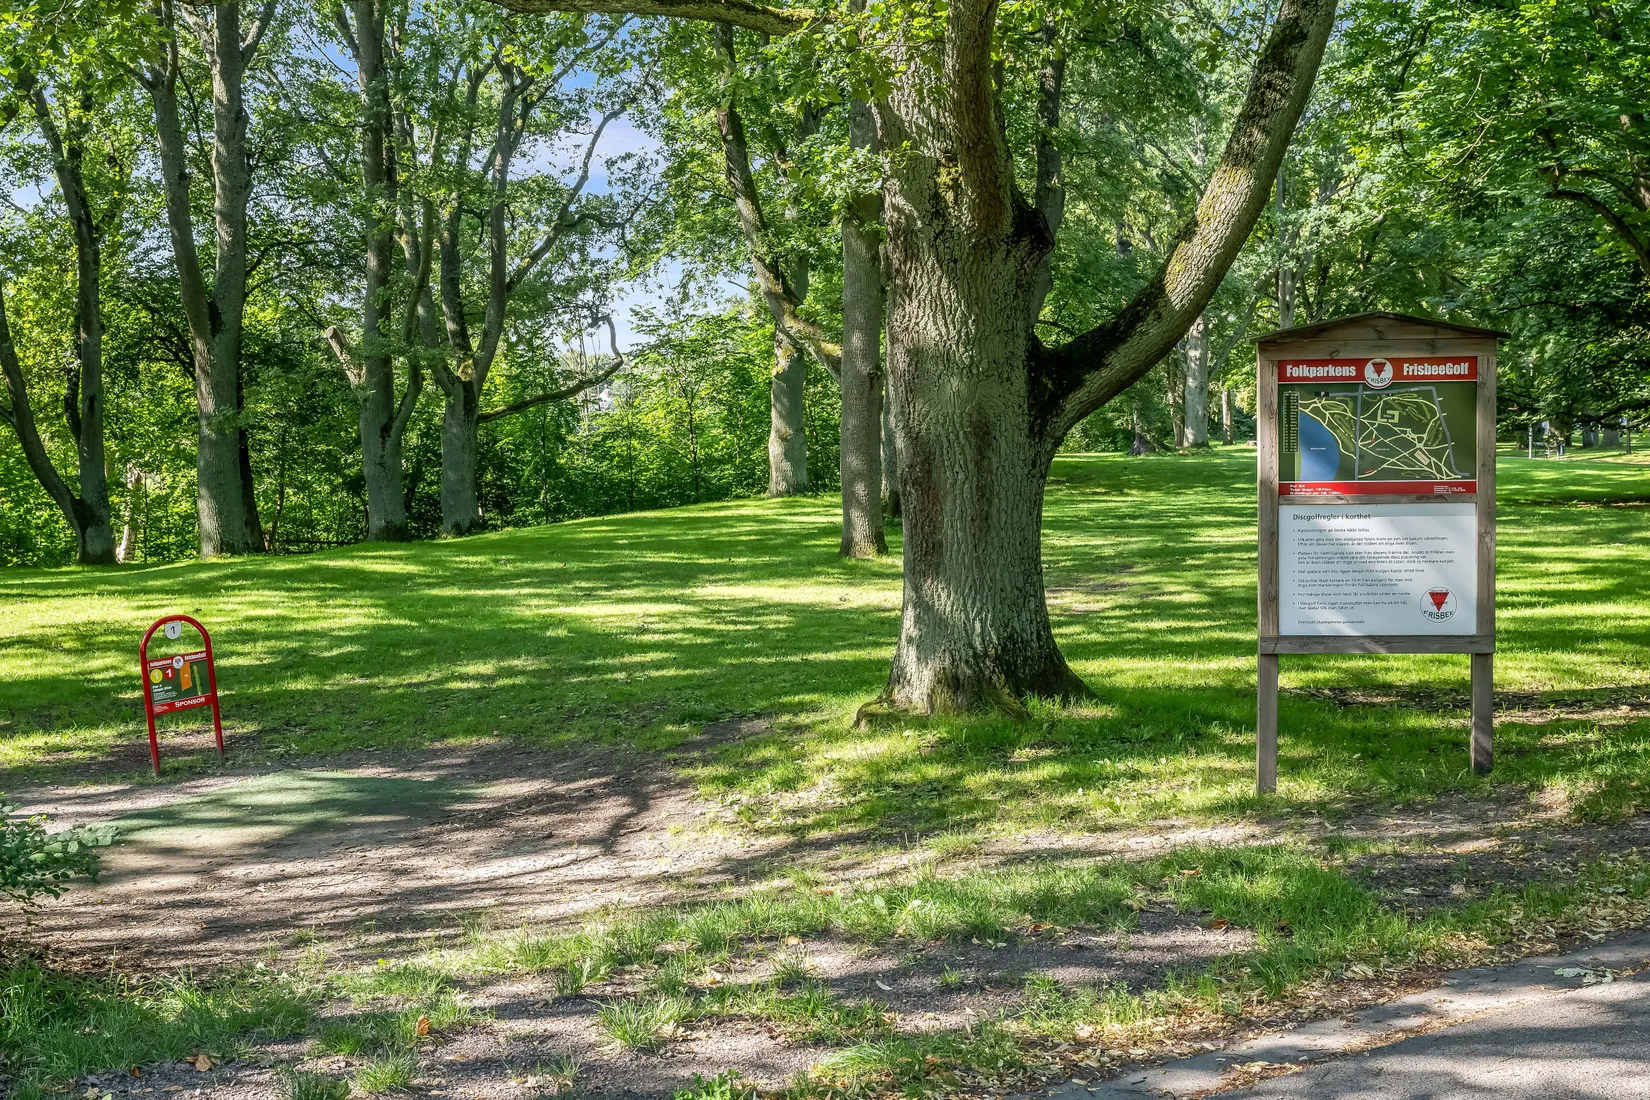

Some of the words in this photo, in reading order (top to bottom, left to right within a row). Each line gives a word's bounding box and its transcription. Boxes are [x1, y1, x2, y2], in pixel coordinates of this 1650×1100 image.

[1286, 364, 1356, 378] Folkparkens
[1403, 363, 1469, 375] FrisbeeGolf
[170, 626, 176, 634] 1
[154, 672, 158, 680] 1
[166, 669, 172, 678] 1
[175, 697, 206, 708] SPONSOR
